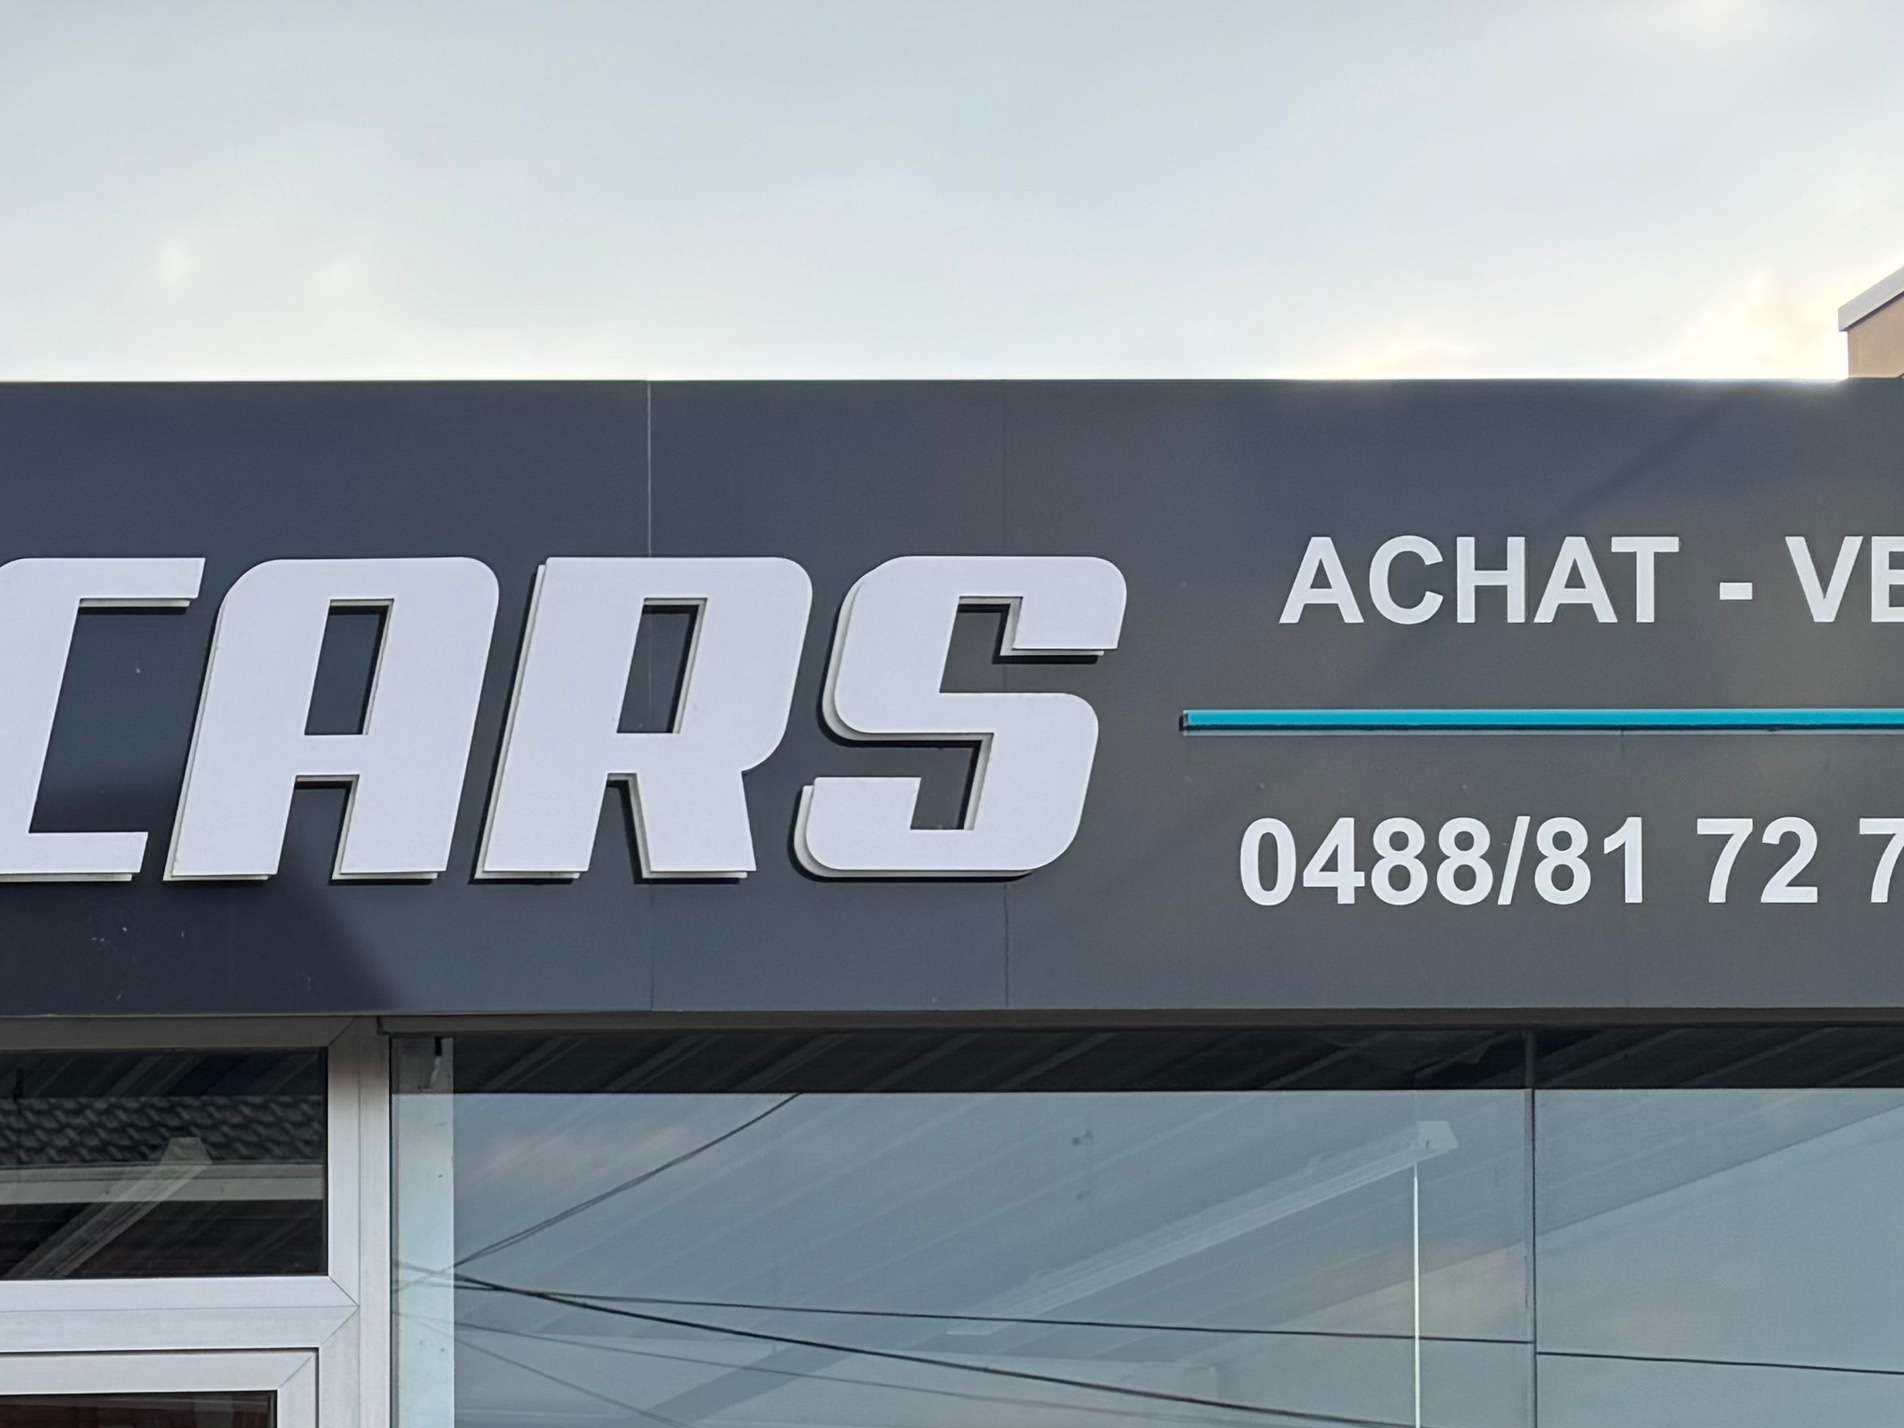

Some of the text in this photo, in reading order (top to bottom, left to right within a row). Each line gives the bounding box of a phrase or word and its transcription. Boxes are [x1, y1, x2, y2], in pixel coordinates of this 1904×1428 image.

[1279, 536, 1680, 624] ACHAT
[1239, 815, 1904, 907] 0488/81 72 7
